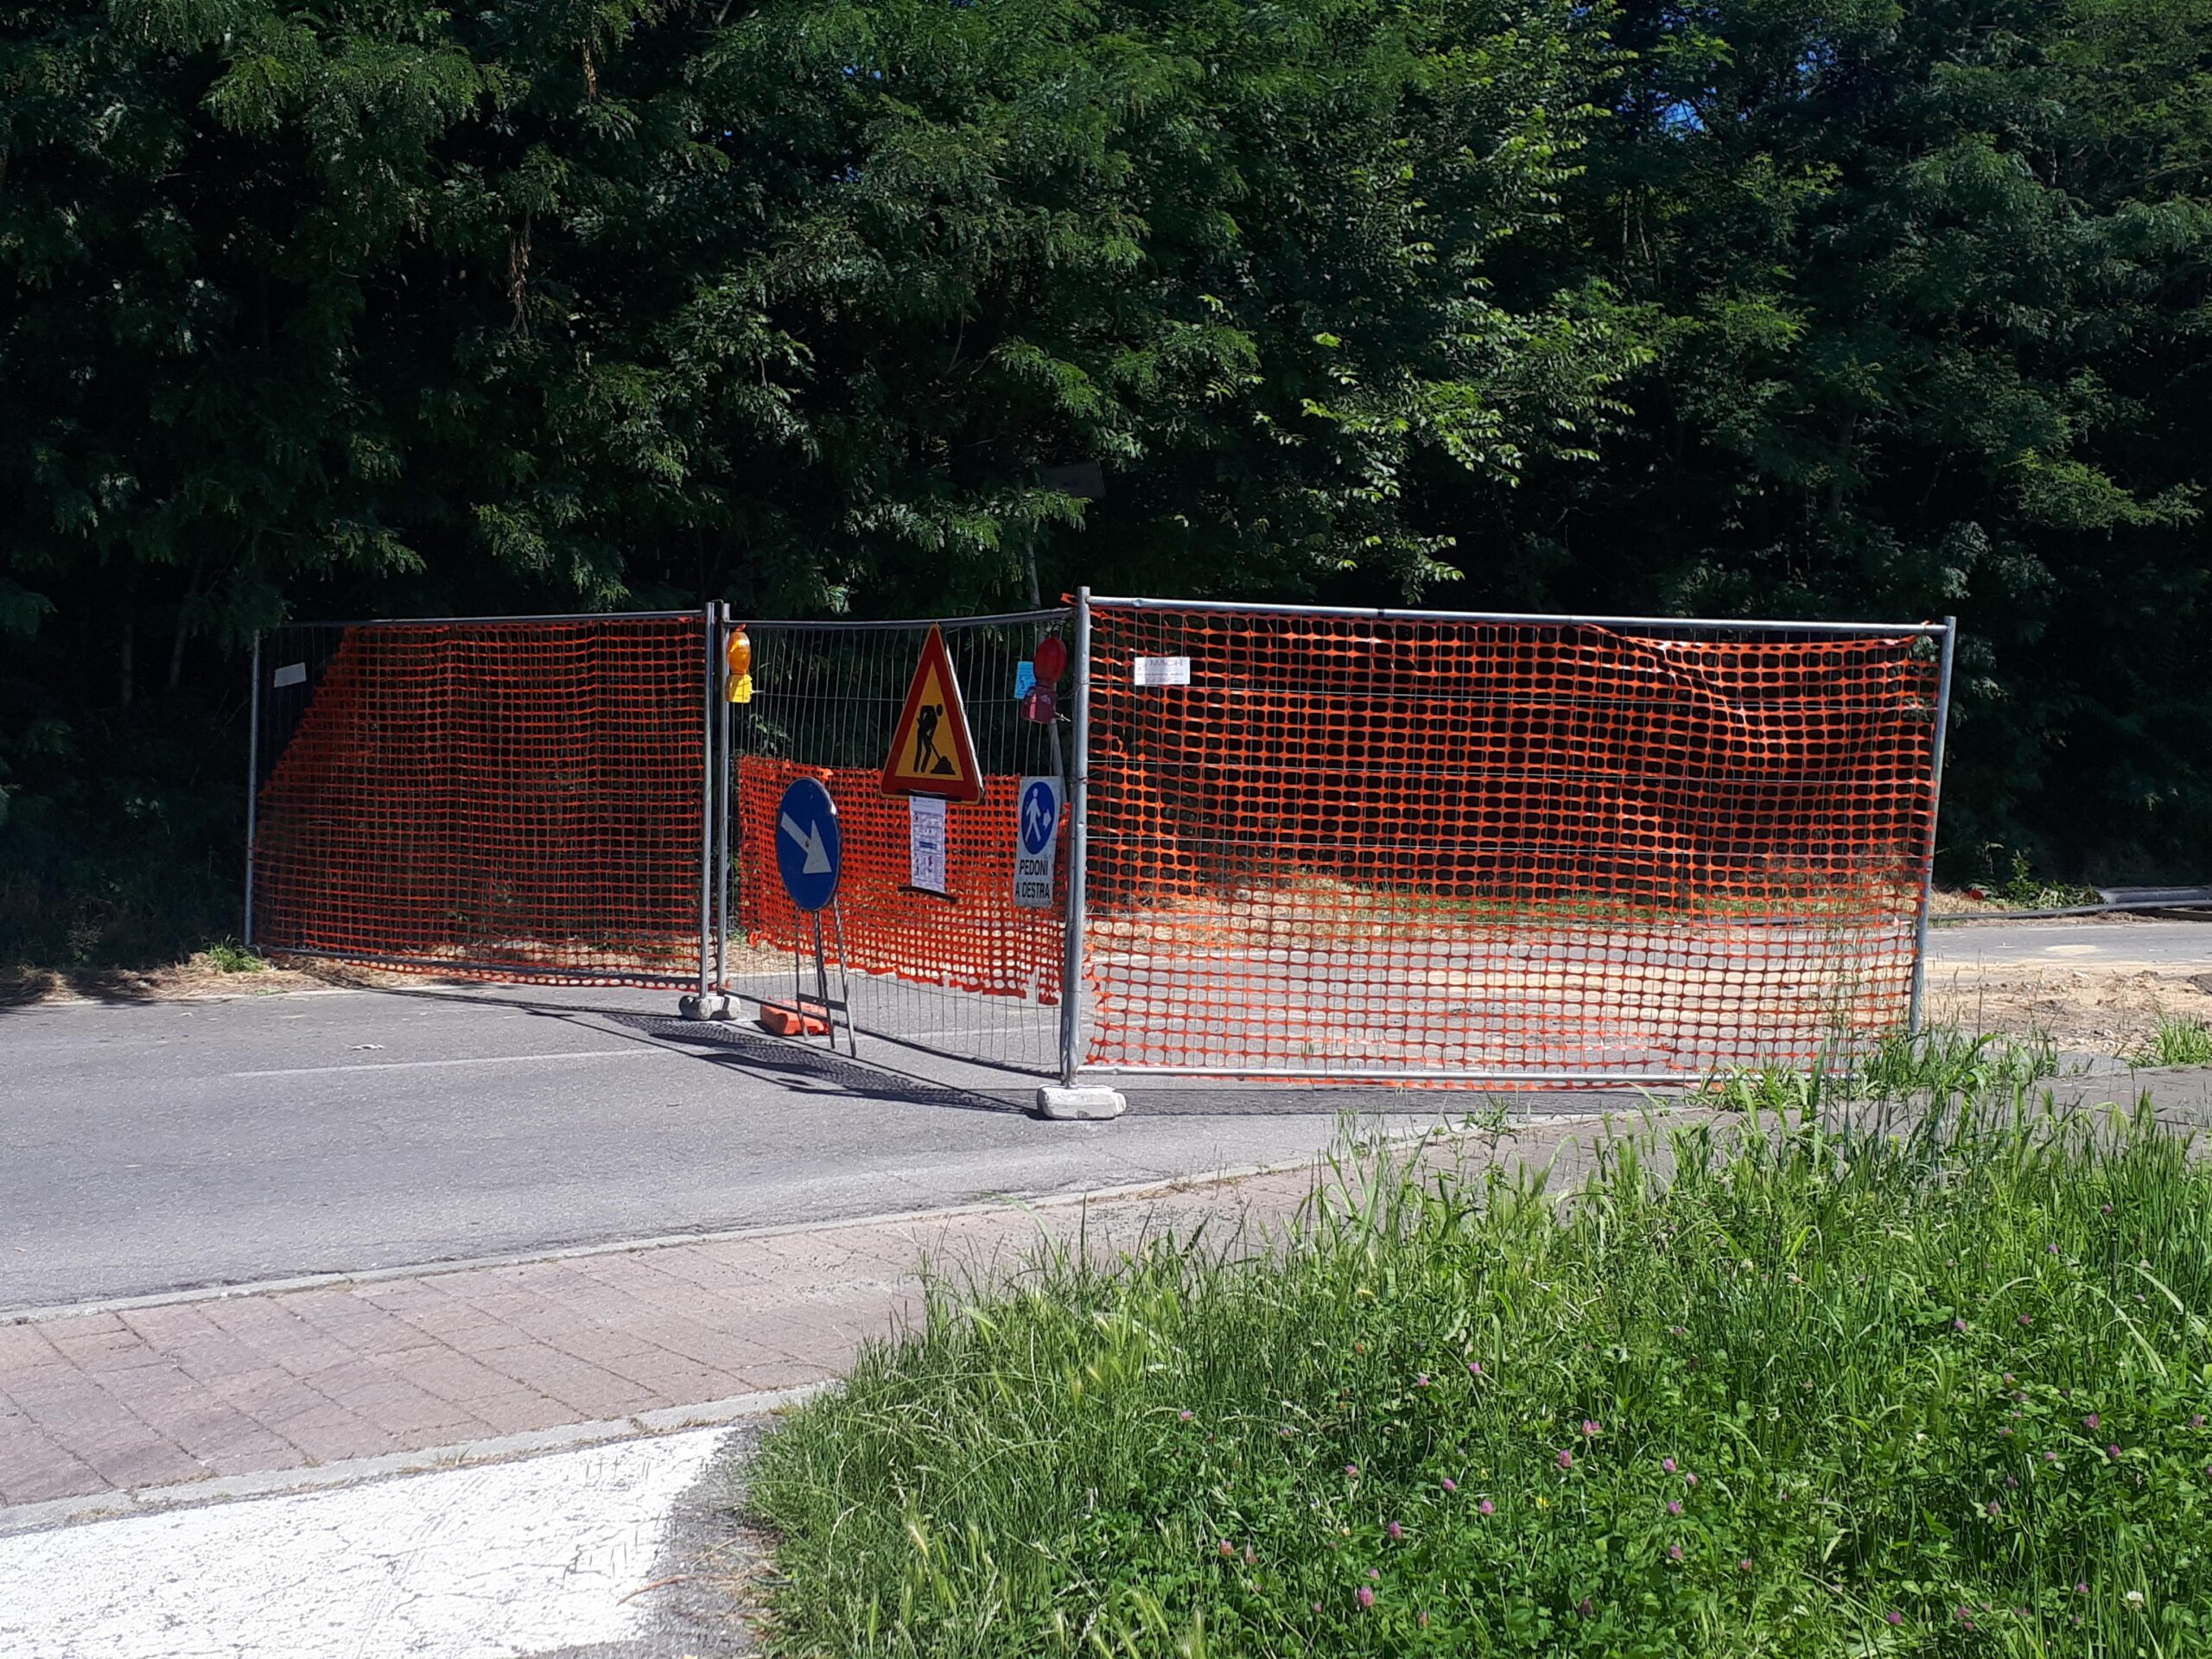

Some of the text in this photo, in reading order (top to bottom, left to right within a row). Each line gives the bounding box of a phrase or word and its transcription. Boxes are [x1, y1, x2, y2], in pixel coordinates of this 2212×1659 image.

[1019, 859, 1048, 876] PEDONI
[1014, 881, 1050, 899] A DESTRA
